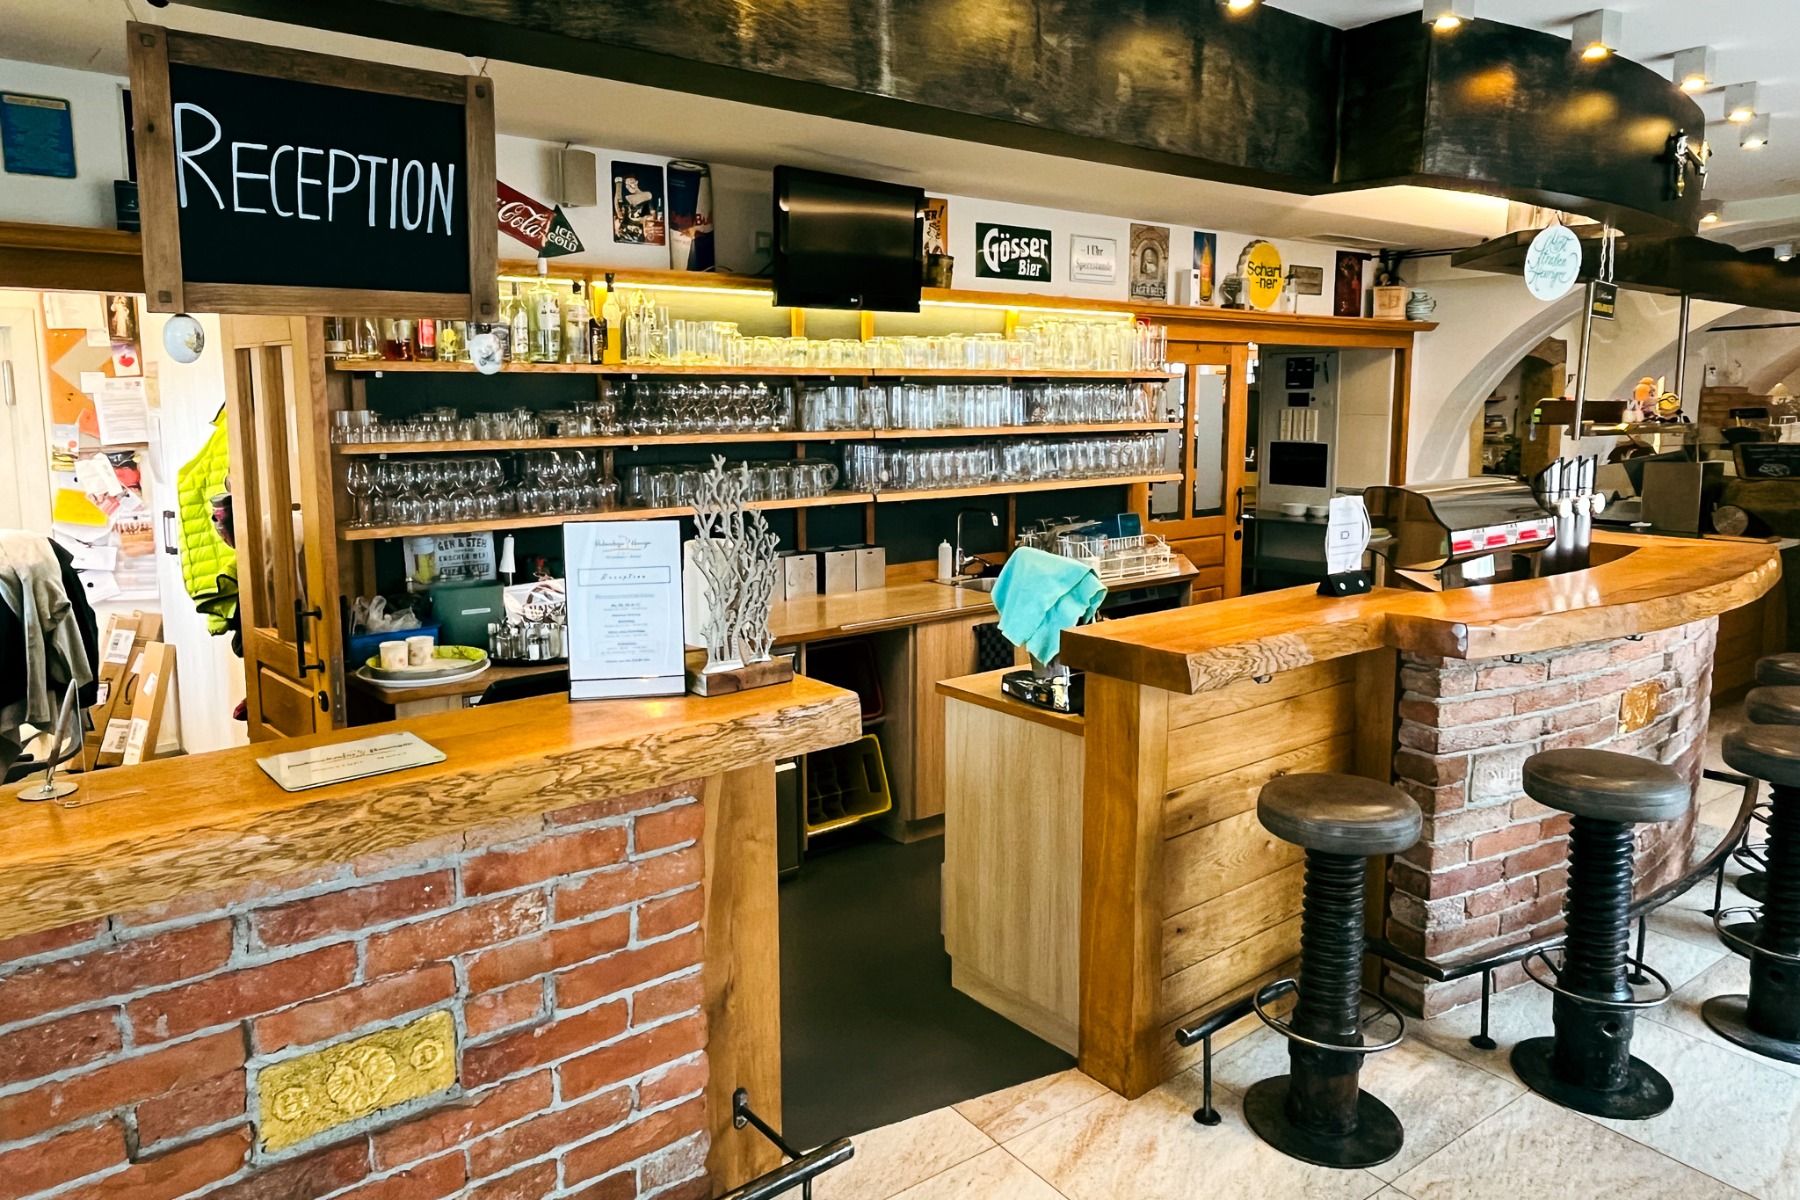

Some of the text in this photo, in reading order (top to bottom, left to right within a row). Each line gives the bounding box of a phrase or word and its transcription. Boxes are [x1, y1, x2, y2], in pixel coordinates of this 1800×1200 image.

[174, 102, 455, 236] RECEPTION
[548, 232, 577, 252] COLD
[555, 226, 574, 241] ICE
[983, 228, 1049, 272] Gösser
[1018, 259, 1042, 277] Bier
[1247, 261, 1282, 278] Schart
